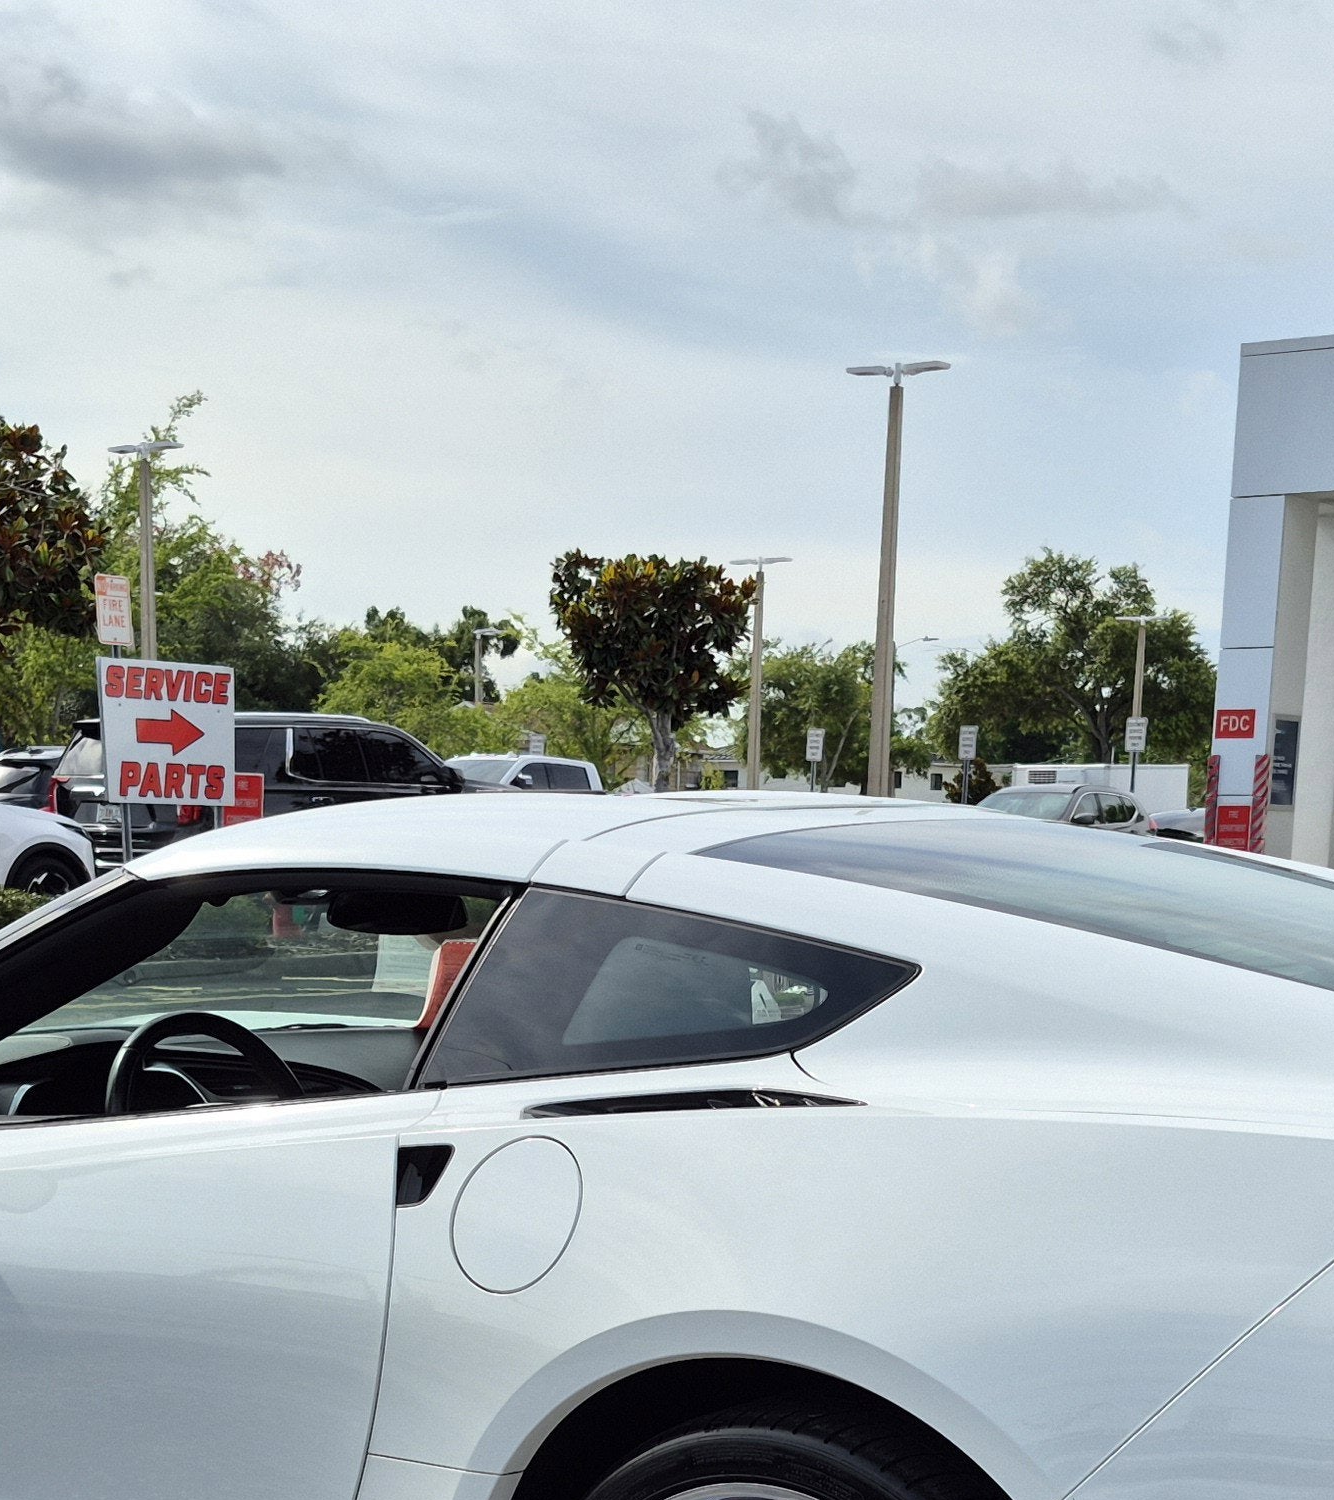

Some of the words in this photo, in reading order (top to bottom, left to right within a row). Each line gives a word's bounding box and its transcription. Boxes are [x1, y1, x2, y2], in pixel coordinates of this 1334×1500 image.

[103, 598, 124, 612] FIRE
[102, 614, 126, 628] LANE
[104, 663, 232, 706] SERVICE
[1219, 715, 1250, 732] FDC
[119, 761, 227, 801] PARTS
